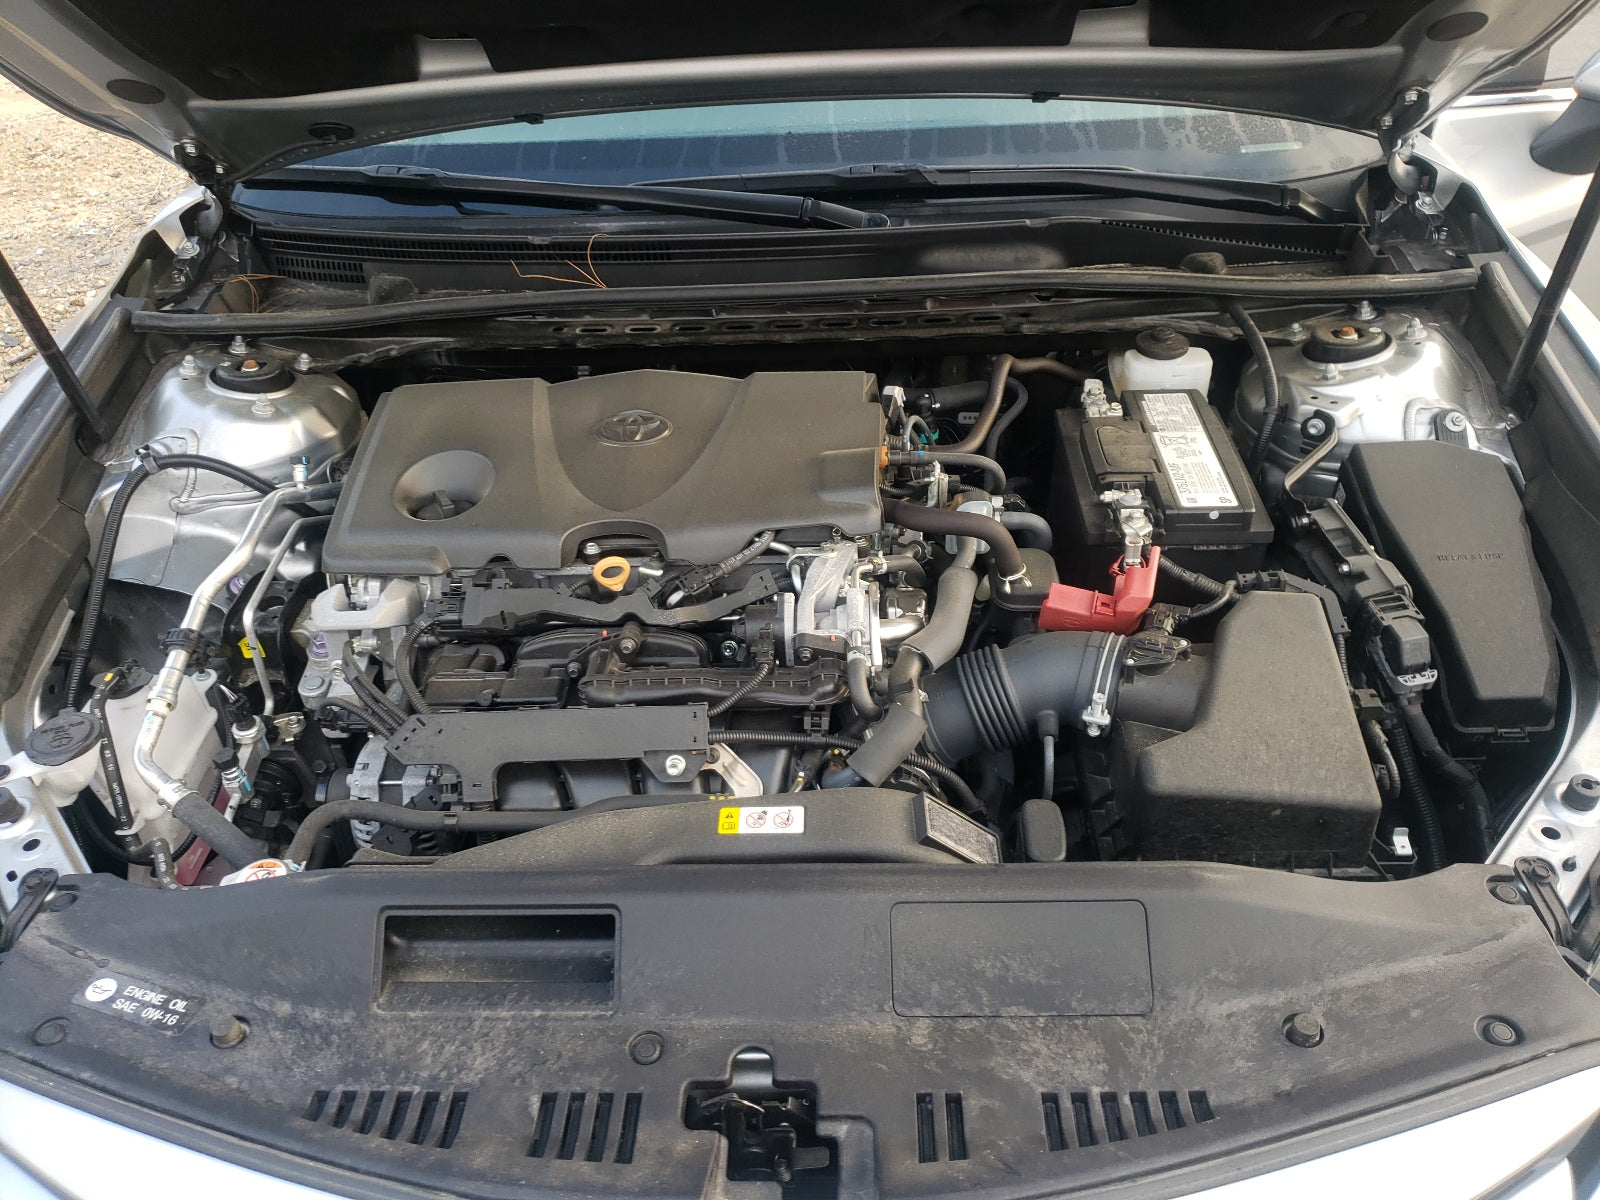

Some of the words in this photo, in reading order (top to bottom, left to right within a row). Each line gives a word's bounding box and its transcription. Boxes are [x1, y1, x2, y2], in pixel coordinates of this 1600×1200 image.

[112, 998, 140, 1013] SAE
[141, 1007, 180, 1026] 0W-16
[123, 985, 168, 1005] ENGINE
[168, 998, 190, 1013] OIL
